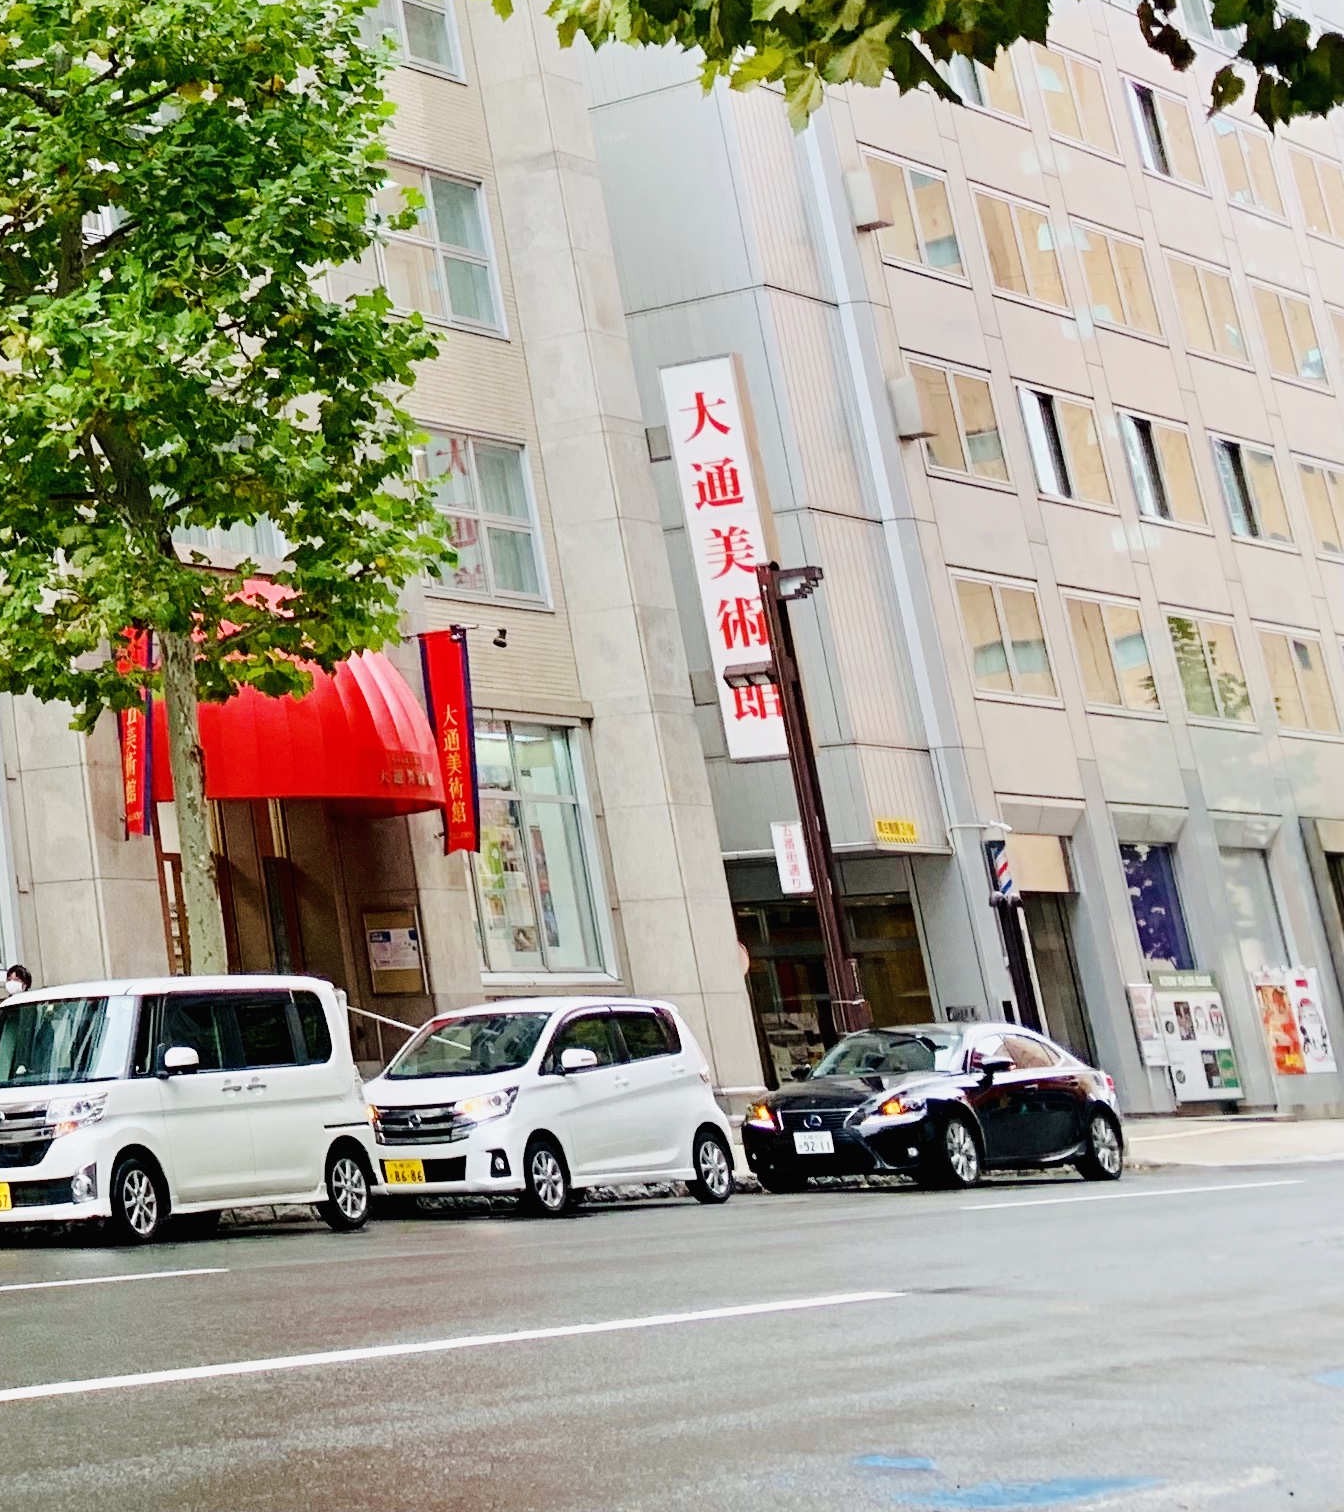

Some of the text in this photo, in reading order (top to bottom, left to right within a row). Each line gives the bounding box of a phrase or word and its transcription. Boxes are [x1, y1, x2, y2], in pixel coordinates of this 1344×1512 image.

[442, 704, 467, 824] 大通美術館
